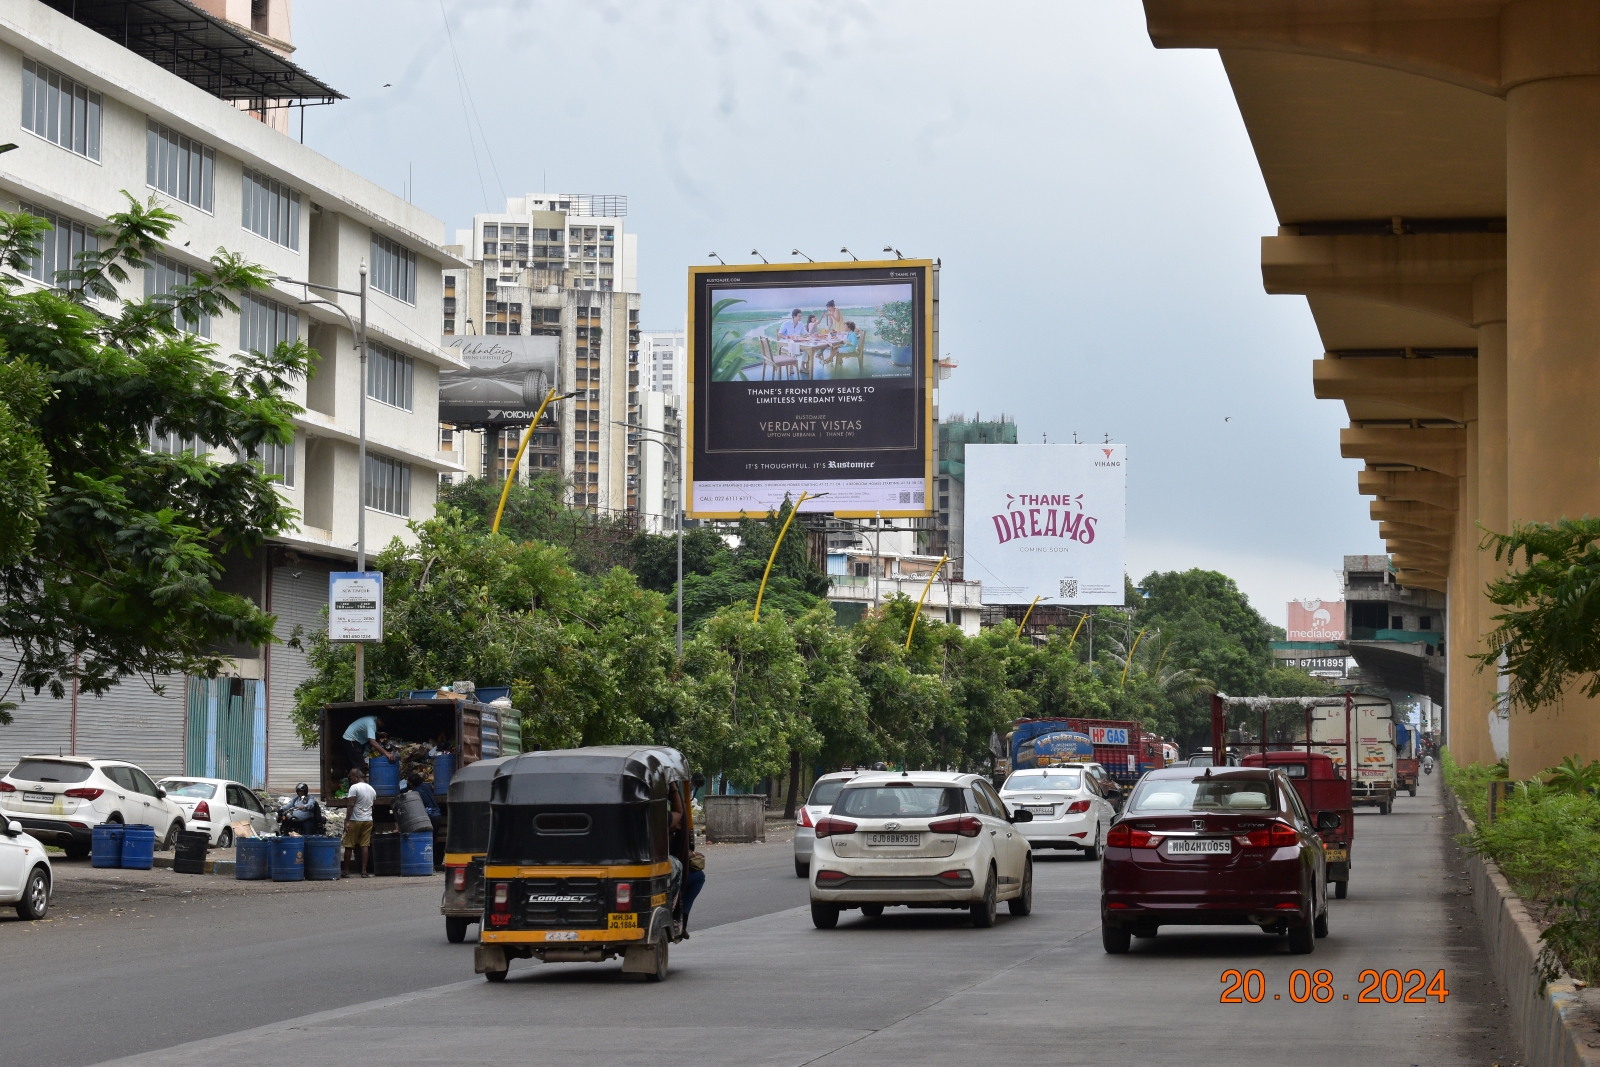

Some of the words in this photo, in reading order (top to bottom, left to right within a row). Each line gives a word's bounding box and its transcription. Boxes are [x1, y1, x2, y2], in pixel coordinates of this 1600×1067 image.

[815, 387, 835, 395] ROW
[837, 395, 865, 403] VIEWS.
[759, 421, 817, 432] VERDANT
[821, 420, 862, 431] VISTAS
[827, 460, 876, 470] Rustomjee
[1019, 494, 1071, 506] THANE
[992, 509, 1098, 544] DREAMS
[1290, 628, 1344, 640] medialogy
[1300, 658, 1344, 667] 67111895
[1093, 728, 1105, 743] HP
[1106, 729, 1125, 744] GAS
[1172, 842, 1230, 852] MH04HX0059
